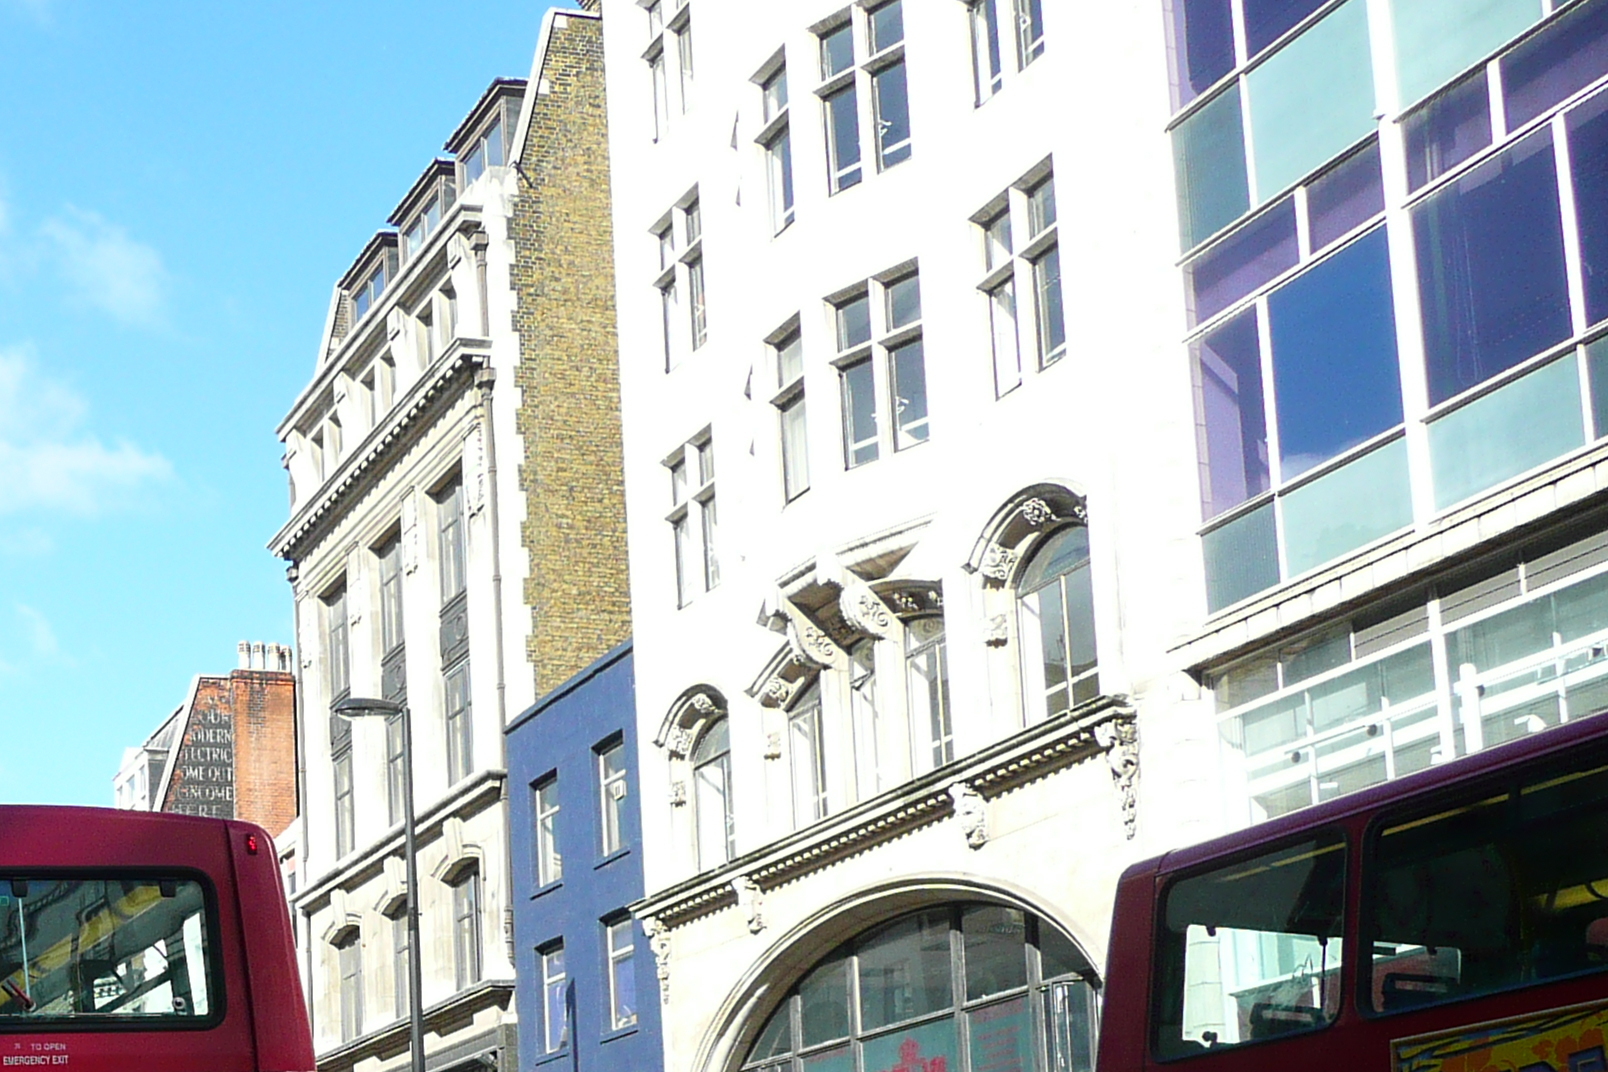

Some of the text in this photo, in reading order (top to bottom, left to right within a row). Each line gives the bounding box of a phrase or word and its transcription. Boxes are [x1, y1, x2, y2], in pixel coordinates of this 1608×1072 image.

[30, 1043, 42, 1051] TO
[44, 1042, 66, 1051] OPEN
[3, 1055, 69, 1066] EMERGENCY EXIT
